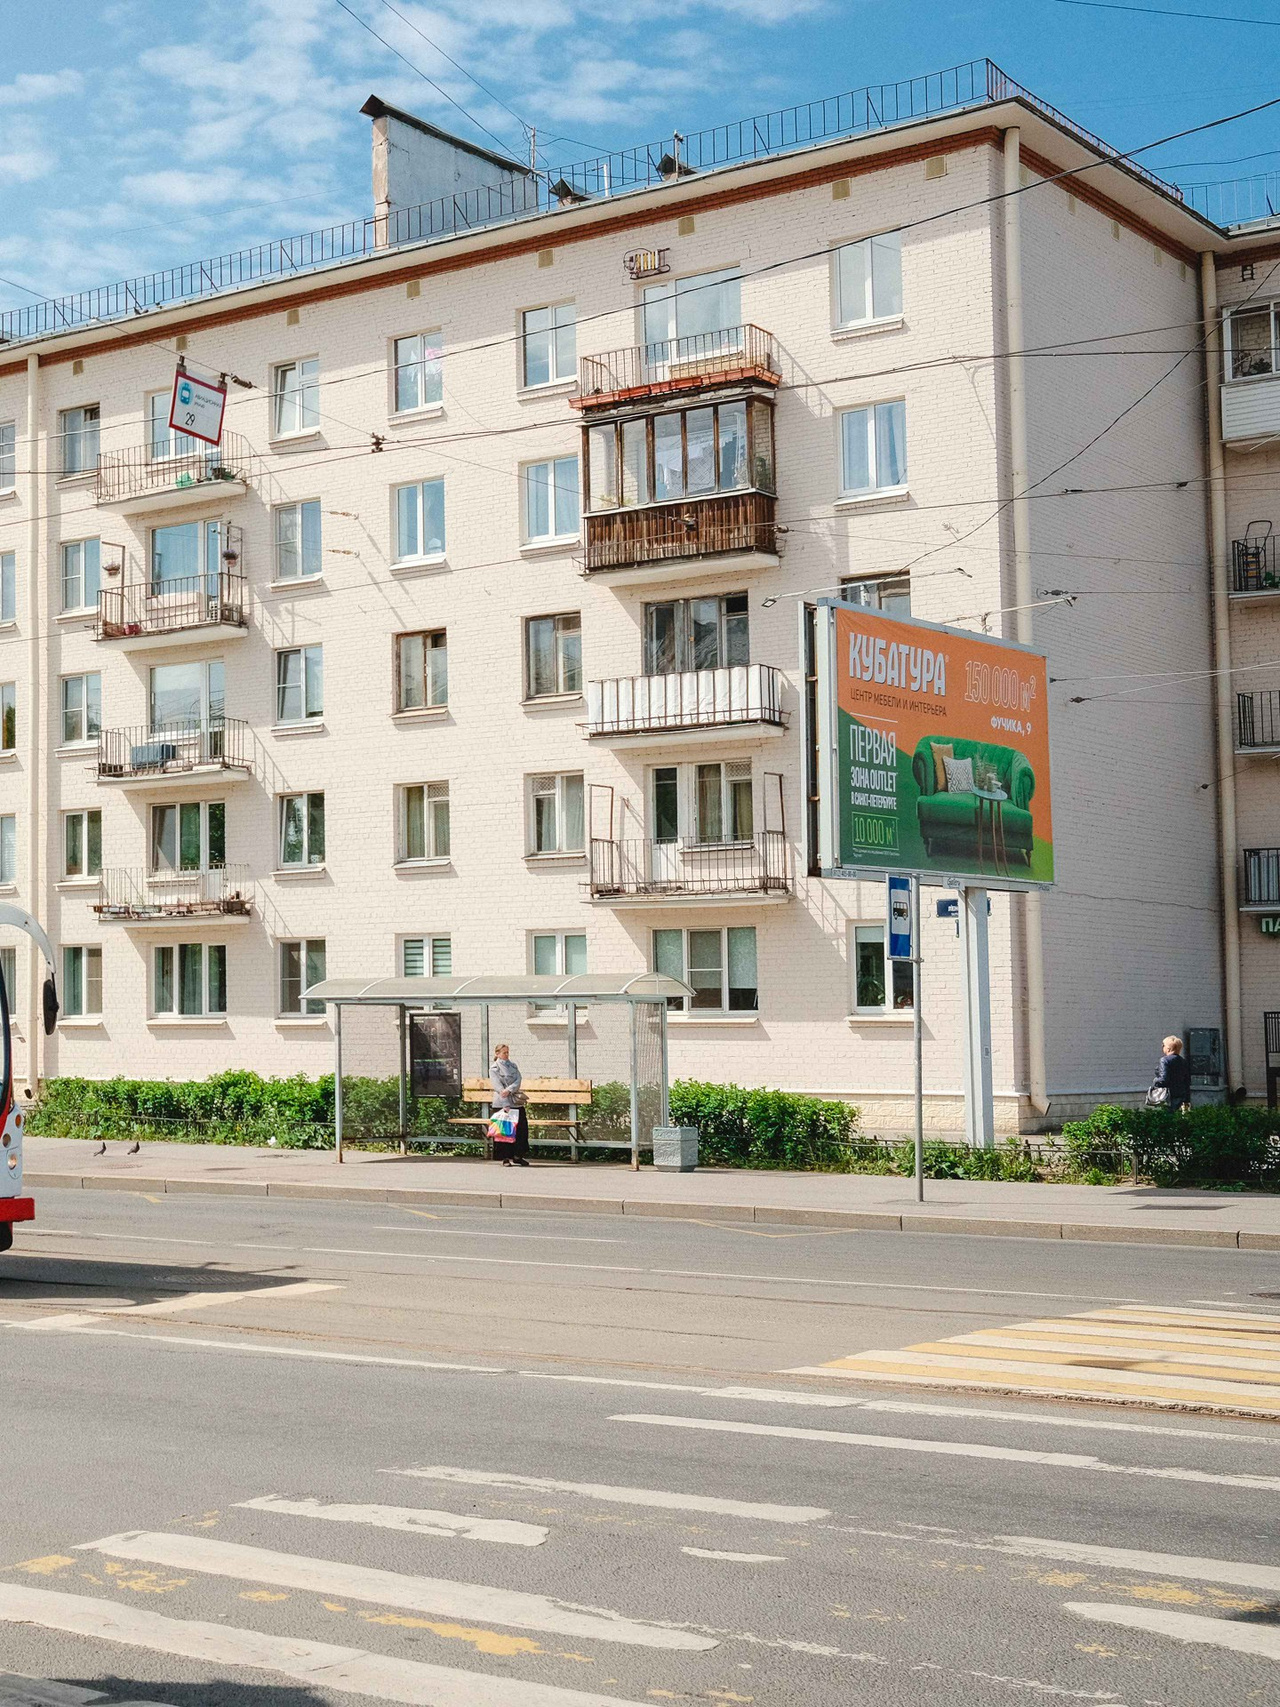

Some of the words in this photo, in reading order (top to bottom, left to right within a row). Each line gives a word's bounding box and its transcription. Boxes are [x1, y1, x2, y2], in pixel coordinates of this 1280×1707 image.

[185, 412, 196, 426] 29
[849, 632, 946, 697] КУБАТУРА
[964, 660, 990, 705] 150
[991, 665, 1019, 710] 000
[850, 687, 873, 702] ЦЕНТР
[873, 693, 901, 709] МЕБЕЛИ
[902, 699, 908, 710] И
[908, 700, 948, 717] ИНТЕРЬЕРА
[990, 715, 1025, 737] ФУЧИКА,
[1025, 721, 1032, 735] 9
[849, 724, 897, 767] ПЕРВАЯ
[850, 765, 870, 789] ЗОНА
[869, 769, 897, 793] OUTLET
[854, 817, 866, 843] 10
[866, 818, 885, 845] 000
